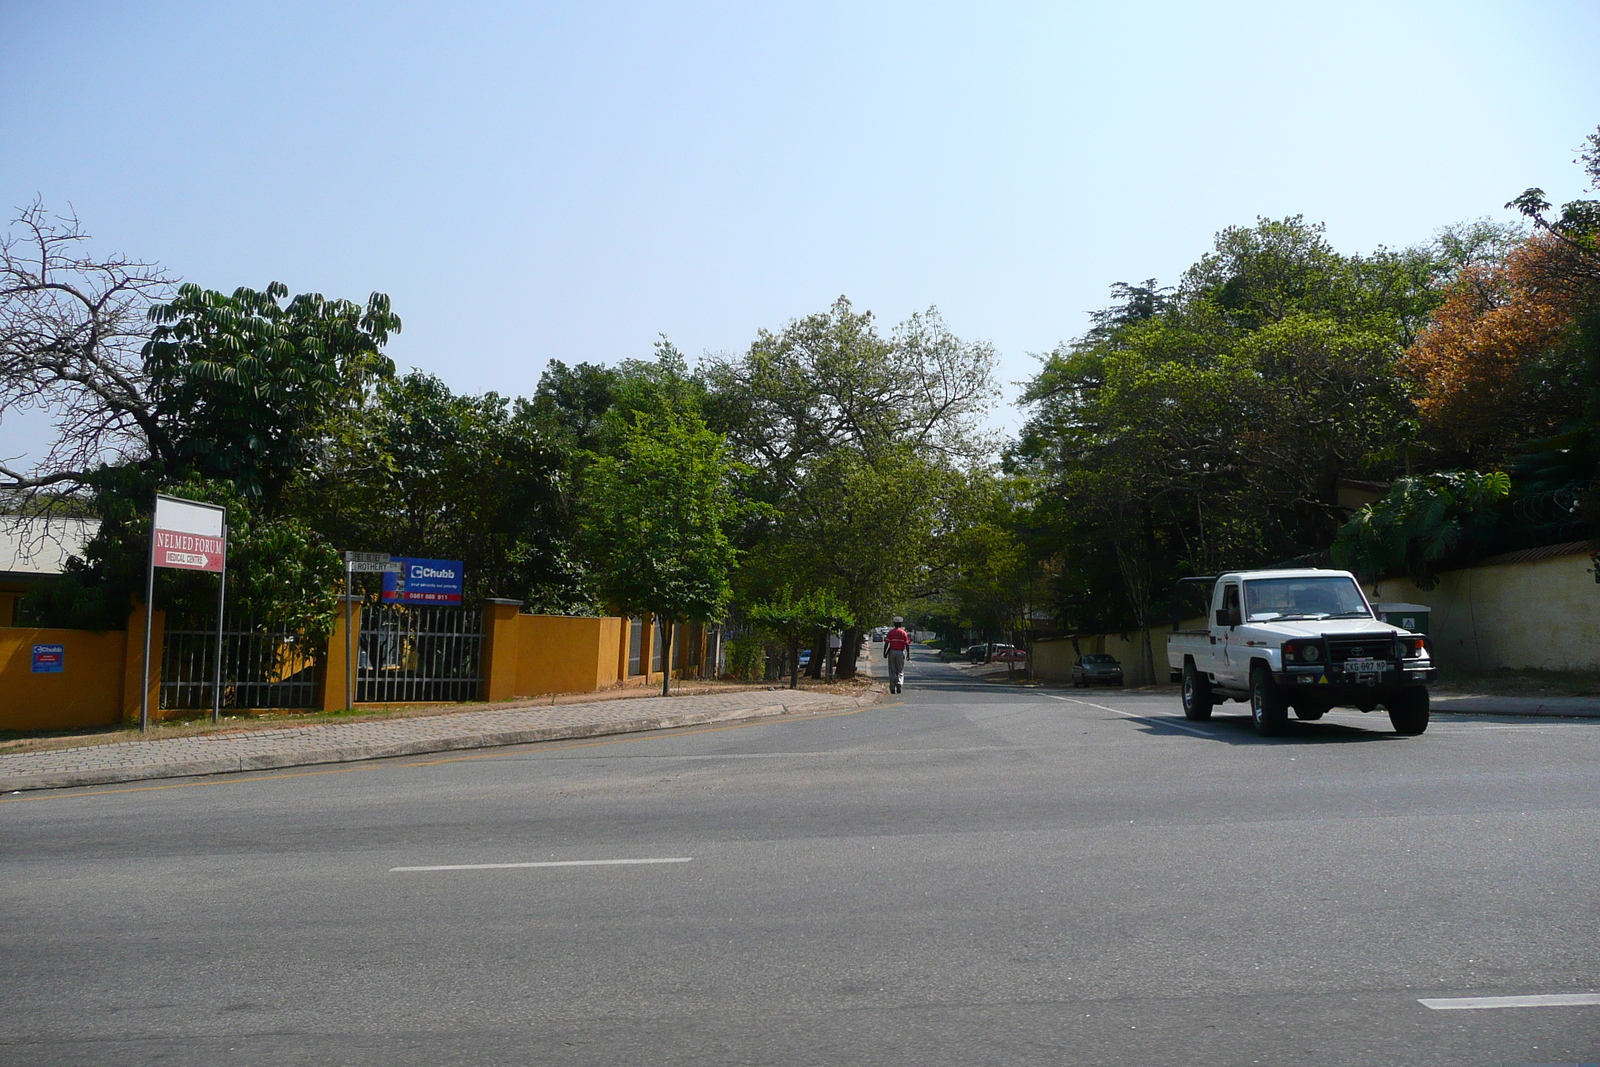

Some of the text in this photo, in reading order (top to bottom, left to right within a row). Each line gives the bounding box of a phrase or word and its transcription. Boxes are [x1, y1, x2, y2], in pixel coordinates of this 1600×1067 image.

[157, 532, 222, 554] NELMED FORUM
[167, 552, 203, 565] MEDICAL CENTRE
[357, 562, 387, 571] ROTHERY
[423, 568, 455, 579] Chubb
[1376, 661, 1386, 670] MP
